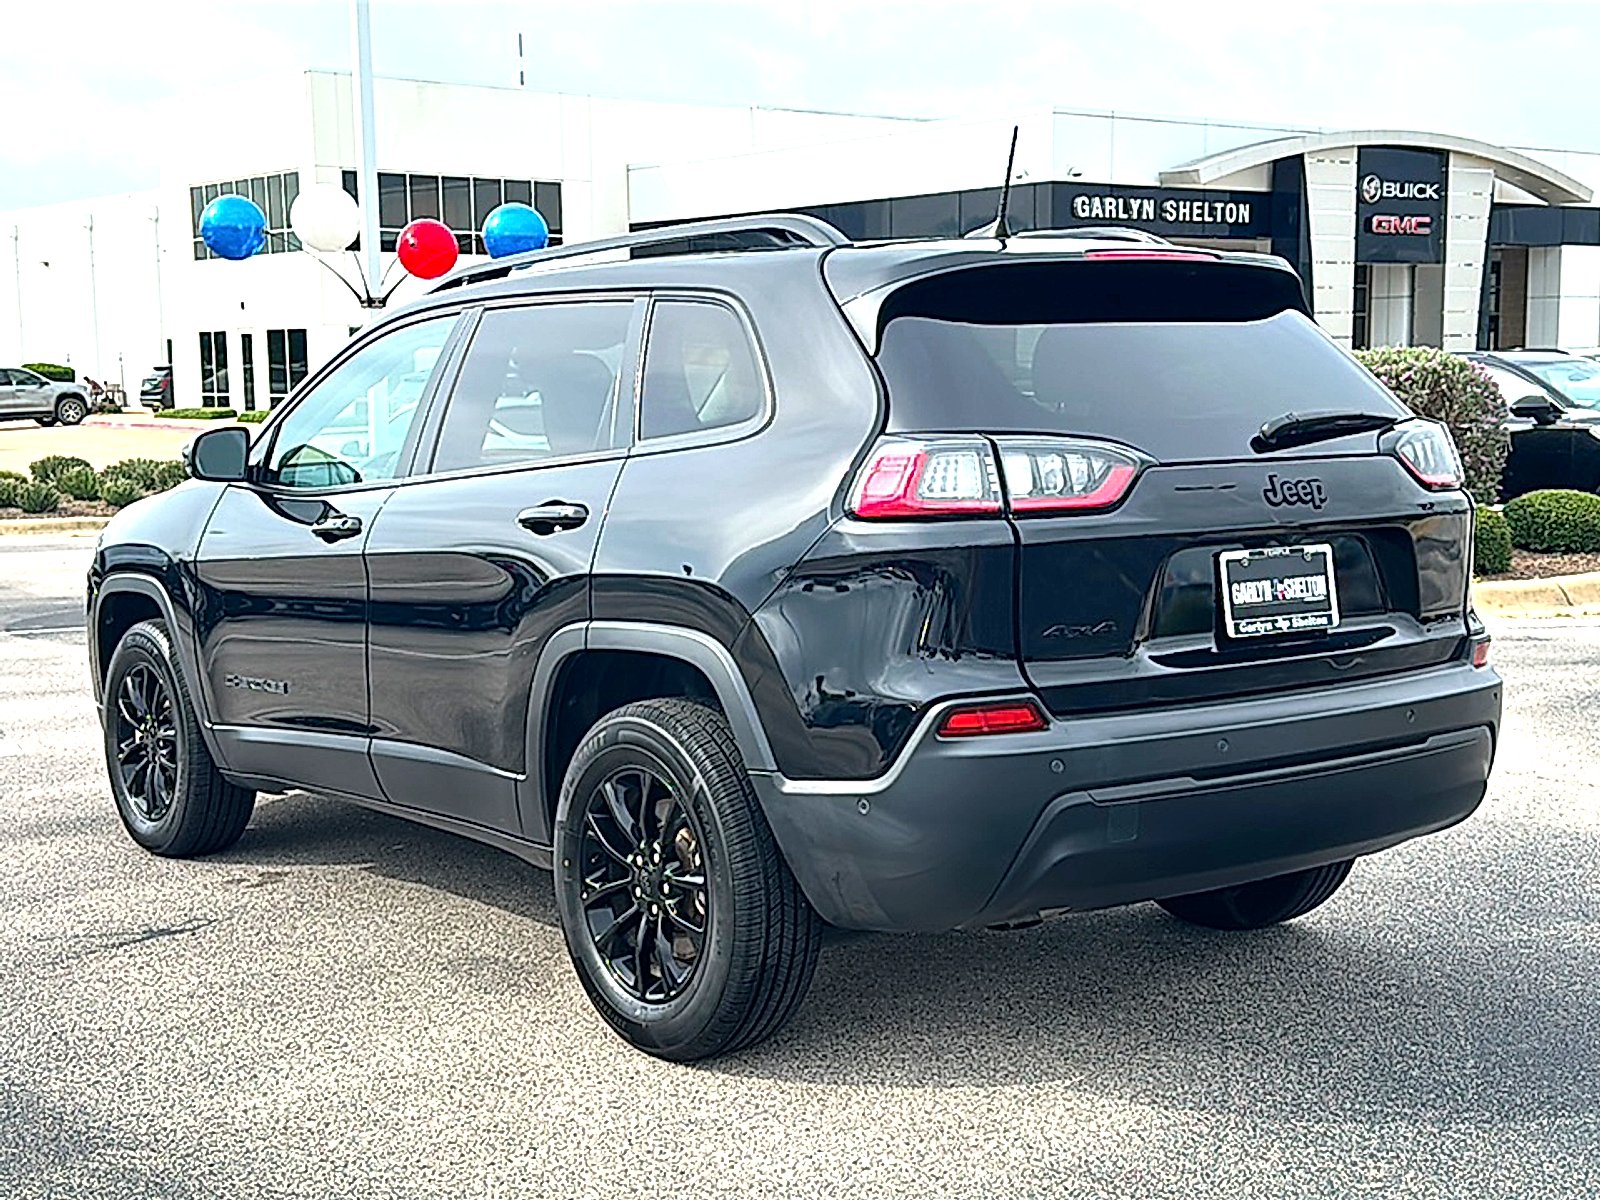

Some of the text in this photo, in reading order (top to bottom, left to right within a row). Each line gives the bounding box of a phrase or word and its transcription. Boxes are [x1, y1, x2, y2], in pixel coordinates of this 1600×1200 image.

[1382, 181, 1439, 199] BUICK
[1074, 196, 1250, 224] GARLYN SHELTON
[1371, 215, 1431, 234] GMC
[1263, 474, 1328, 510] Jeep
